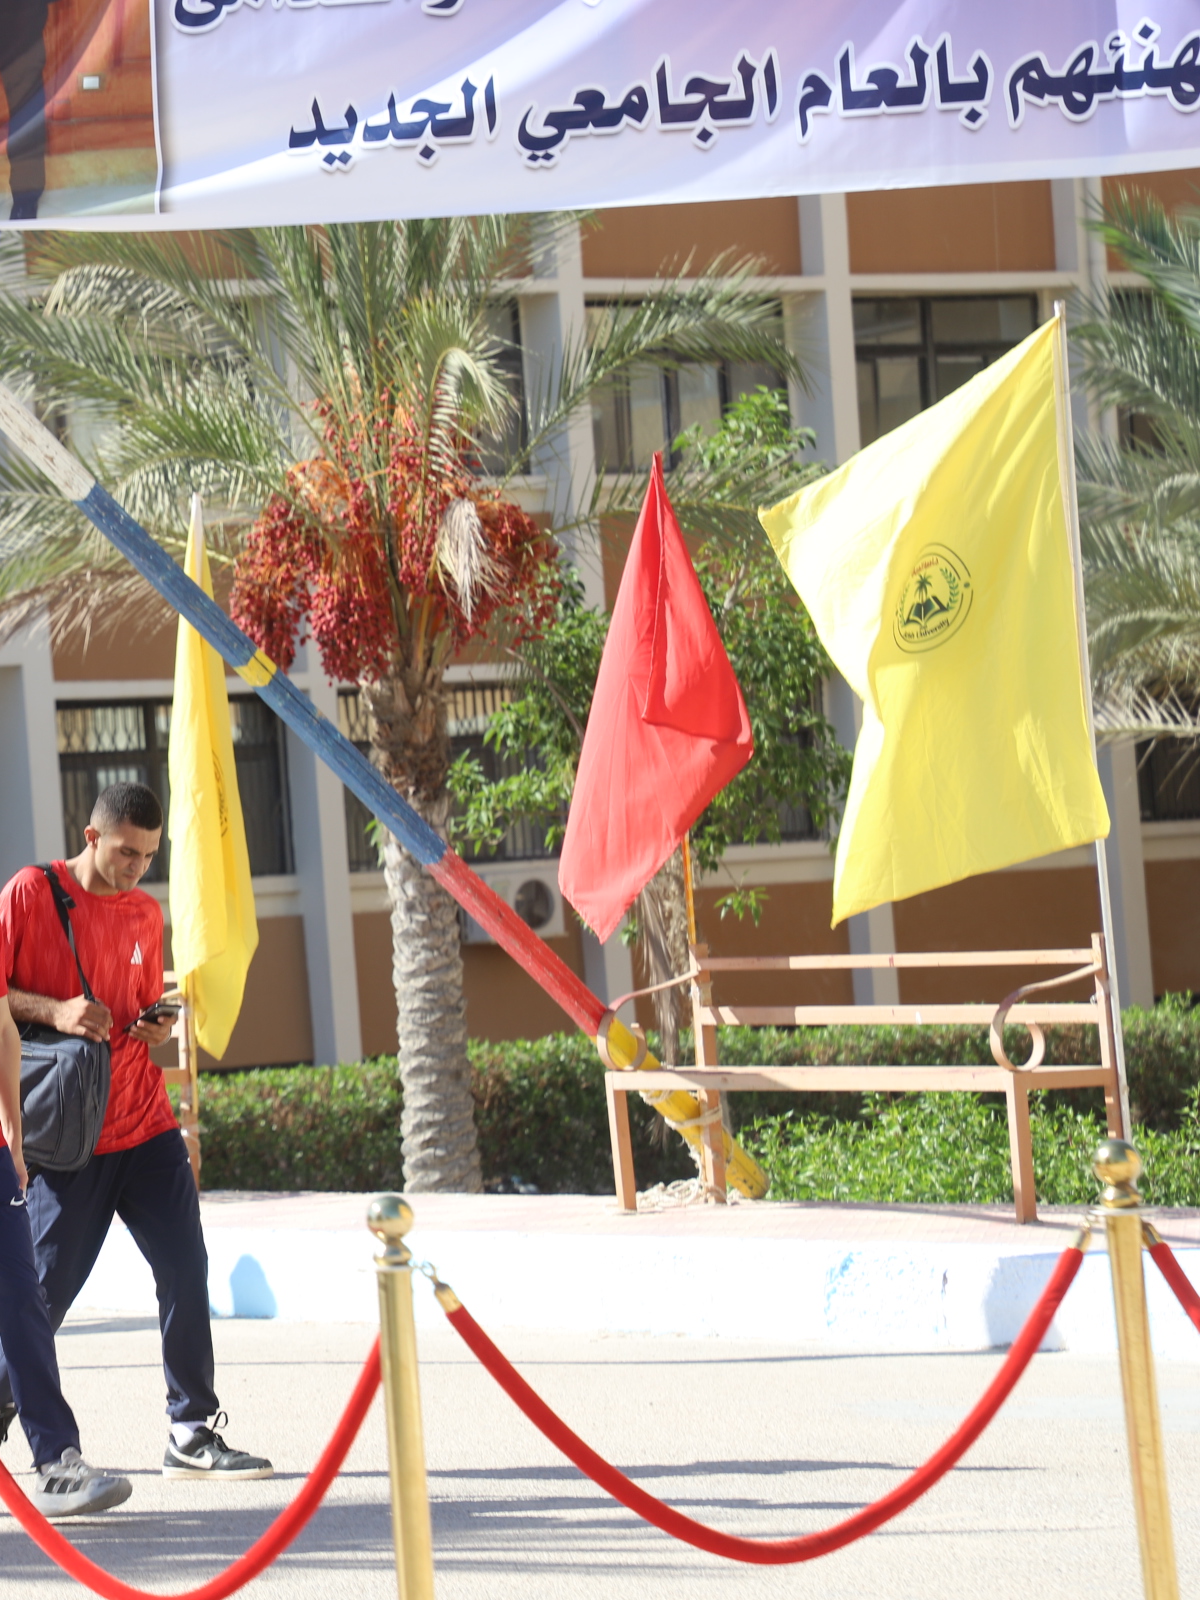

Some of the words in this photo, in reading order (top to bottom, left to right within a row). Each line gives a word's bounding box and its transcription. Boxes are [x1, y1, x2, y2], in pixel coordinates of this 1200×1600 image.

[288, 75, 497, 166] الجديد
[517, 52, 778, 162] الجامعي
[799, 39, 990, 138] بالعام
[1007, 24, 1200, 123] هنئهم
